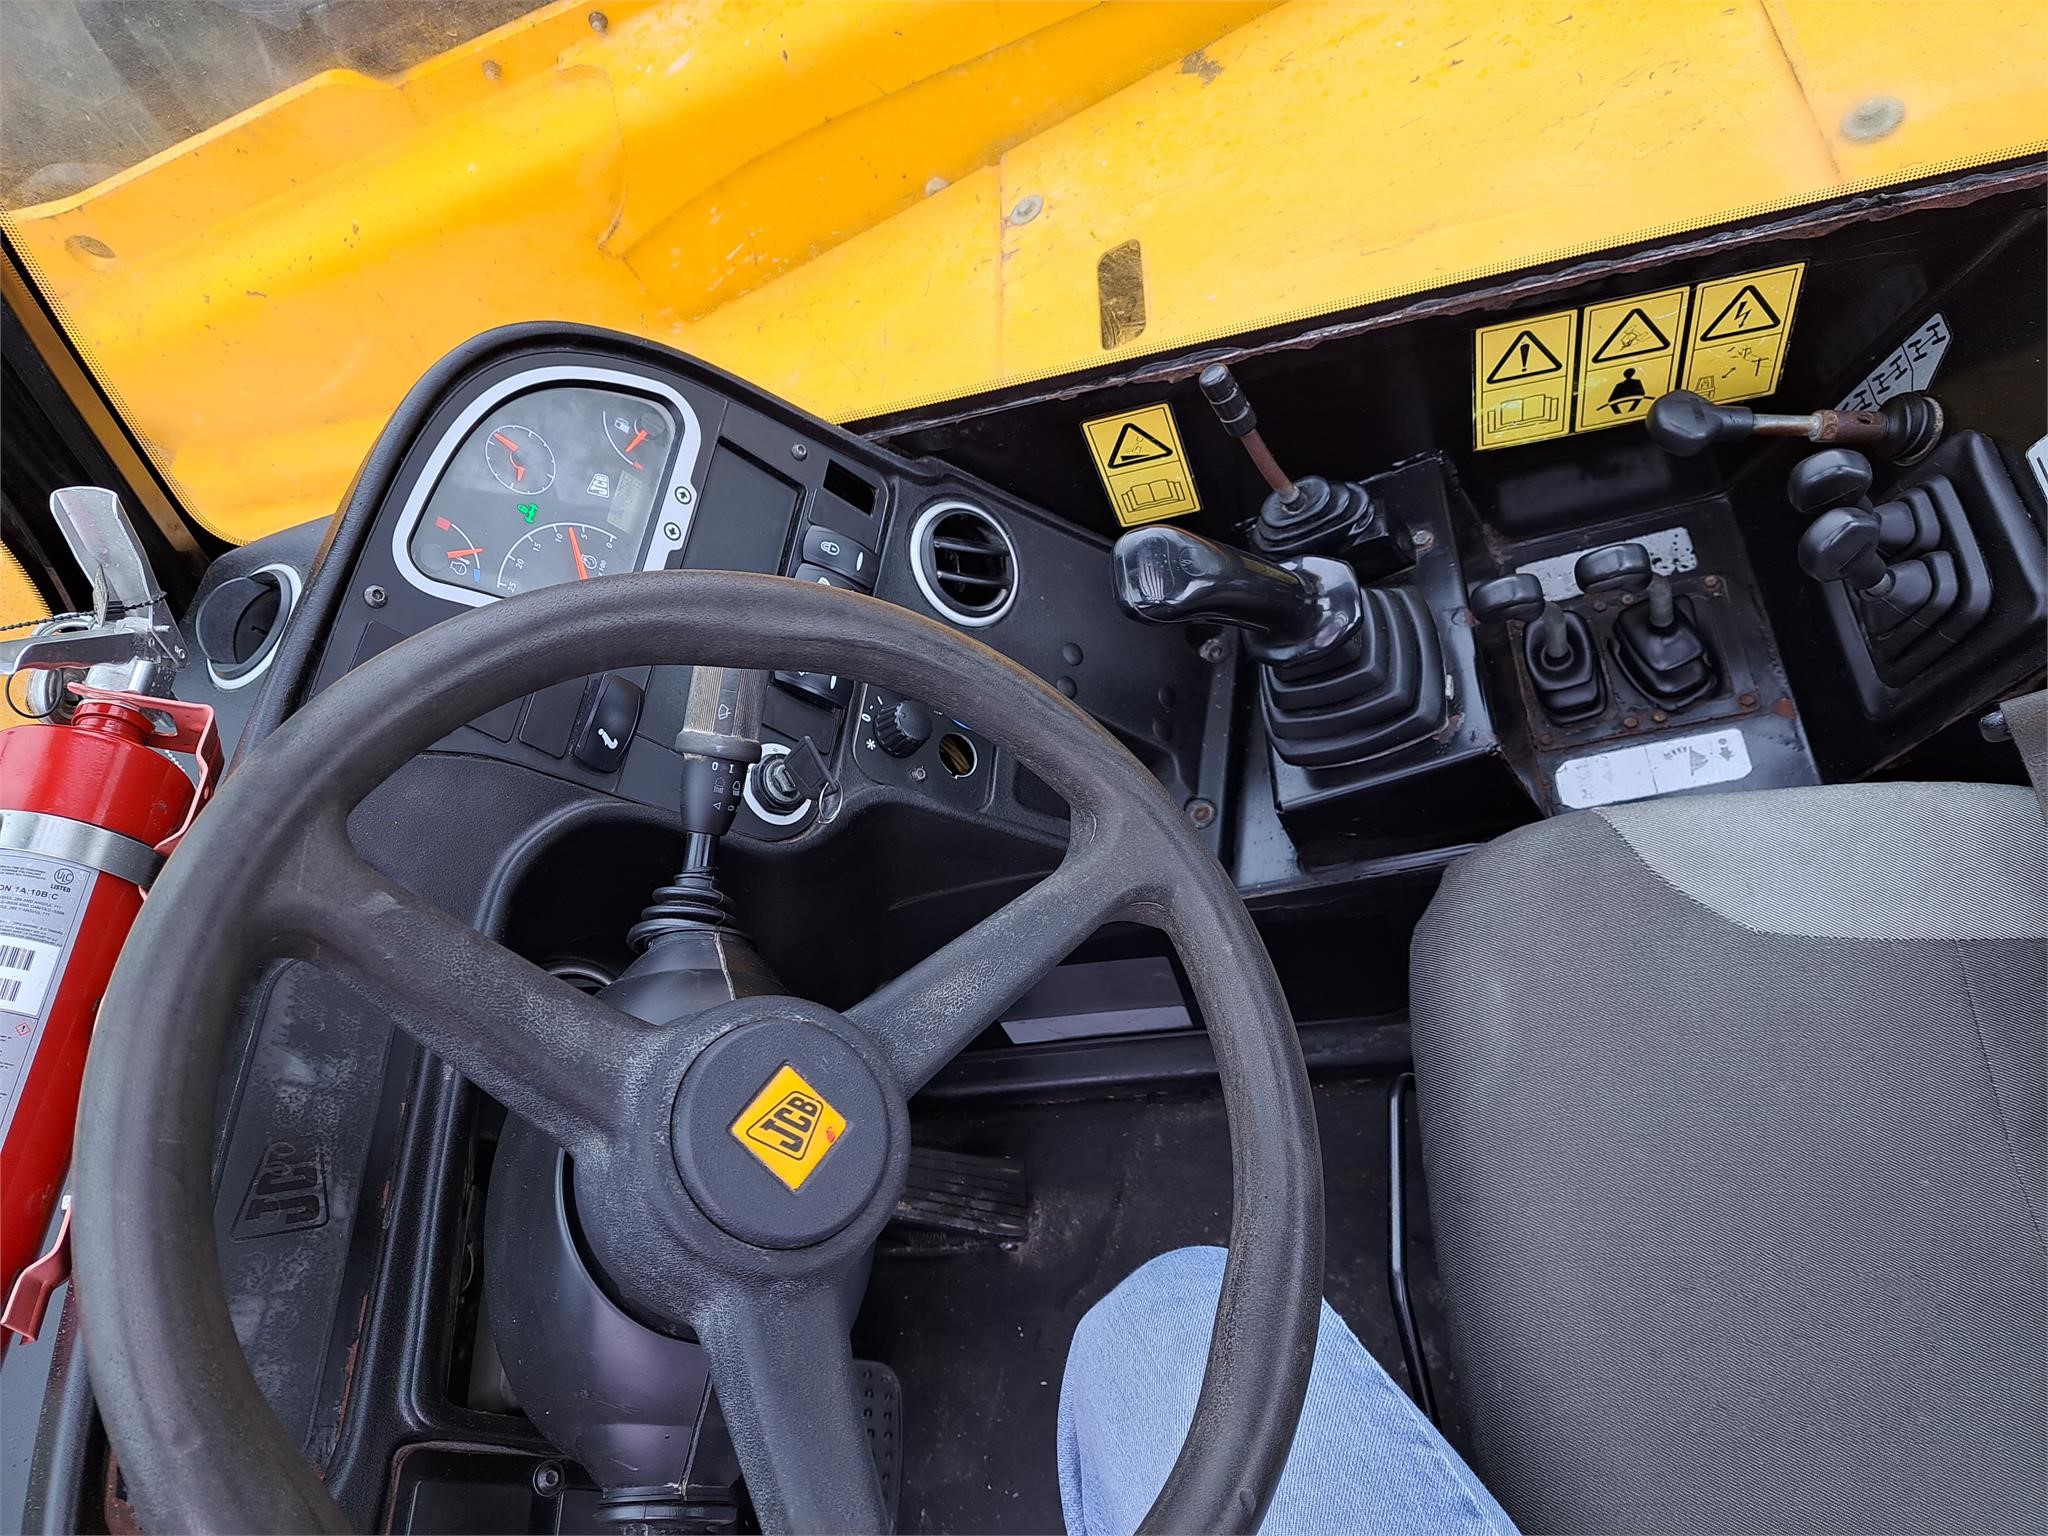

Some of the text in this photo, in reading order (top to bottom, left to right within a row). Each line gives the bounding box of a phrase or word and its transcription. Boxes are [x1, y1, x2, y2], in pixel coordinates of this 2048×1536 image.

[588, 475, 608, 496] JCB
[554, 533, 563, 543] 10
[532, 542, 542, 552] 15
[515, 558, 525, 569] 20
[598, 559, 607, 571] 100
[507, 581, 517, 593] 25
[56, 871, 73, 883] ULC
[50, 883, 72, 893] LISTED
[759, 1096, 818, 1153] JCB
[245, 1142, 320, 1224] JC
